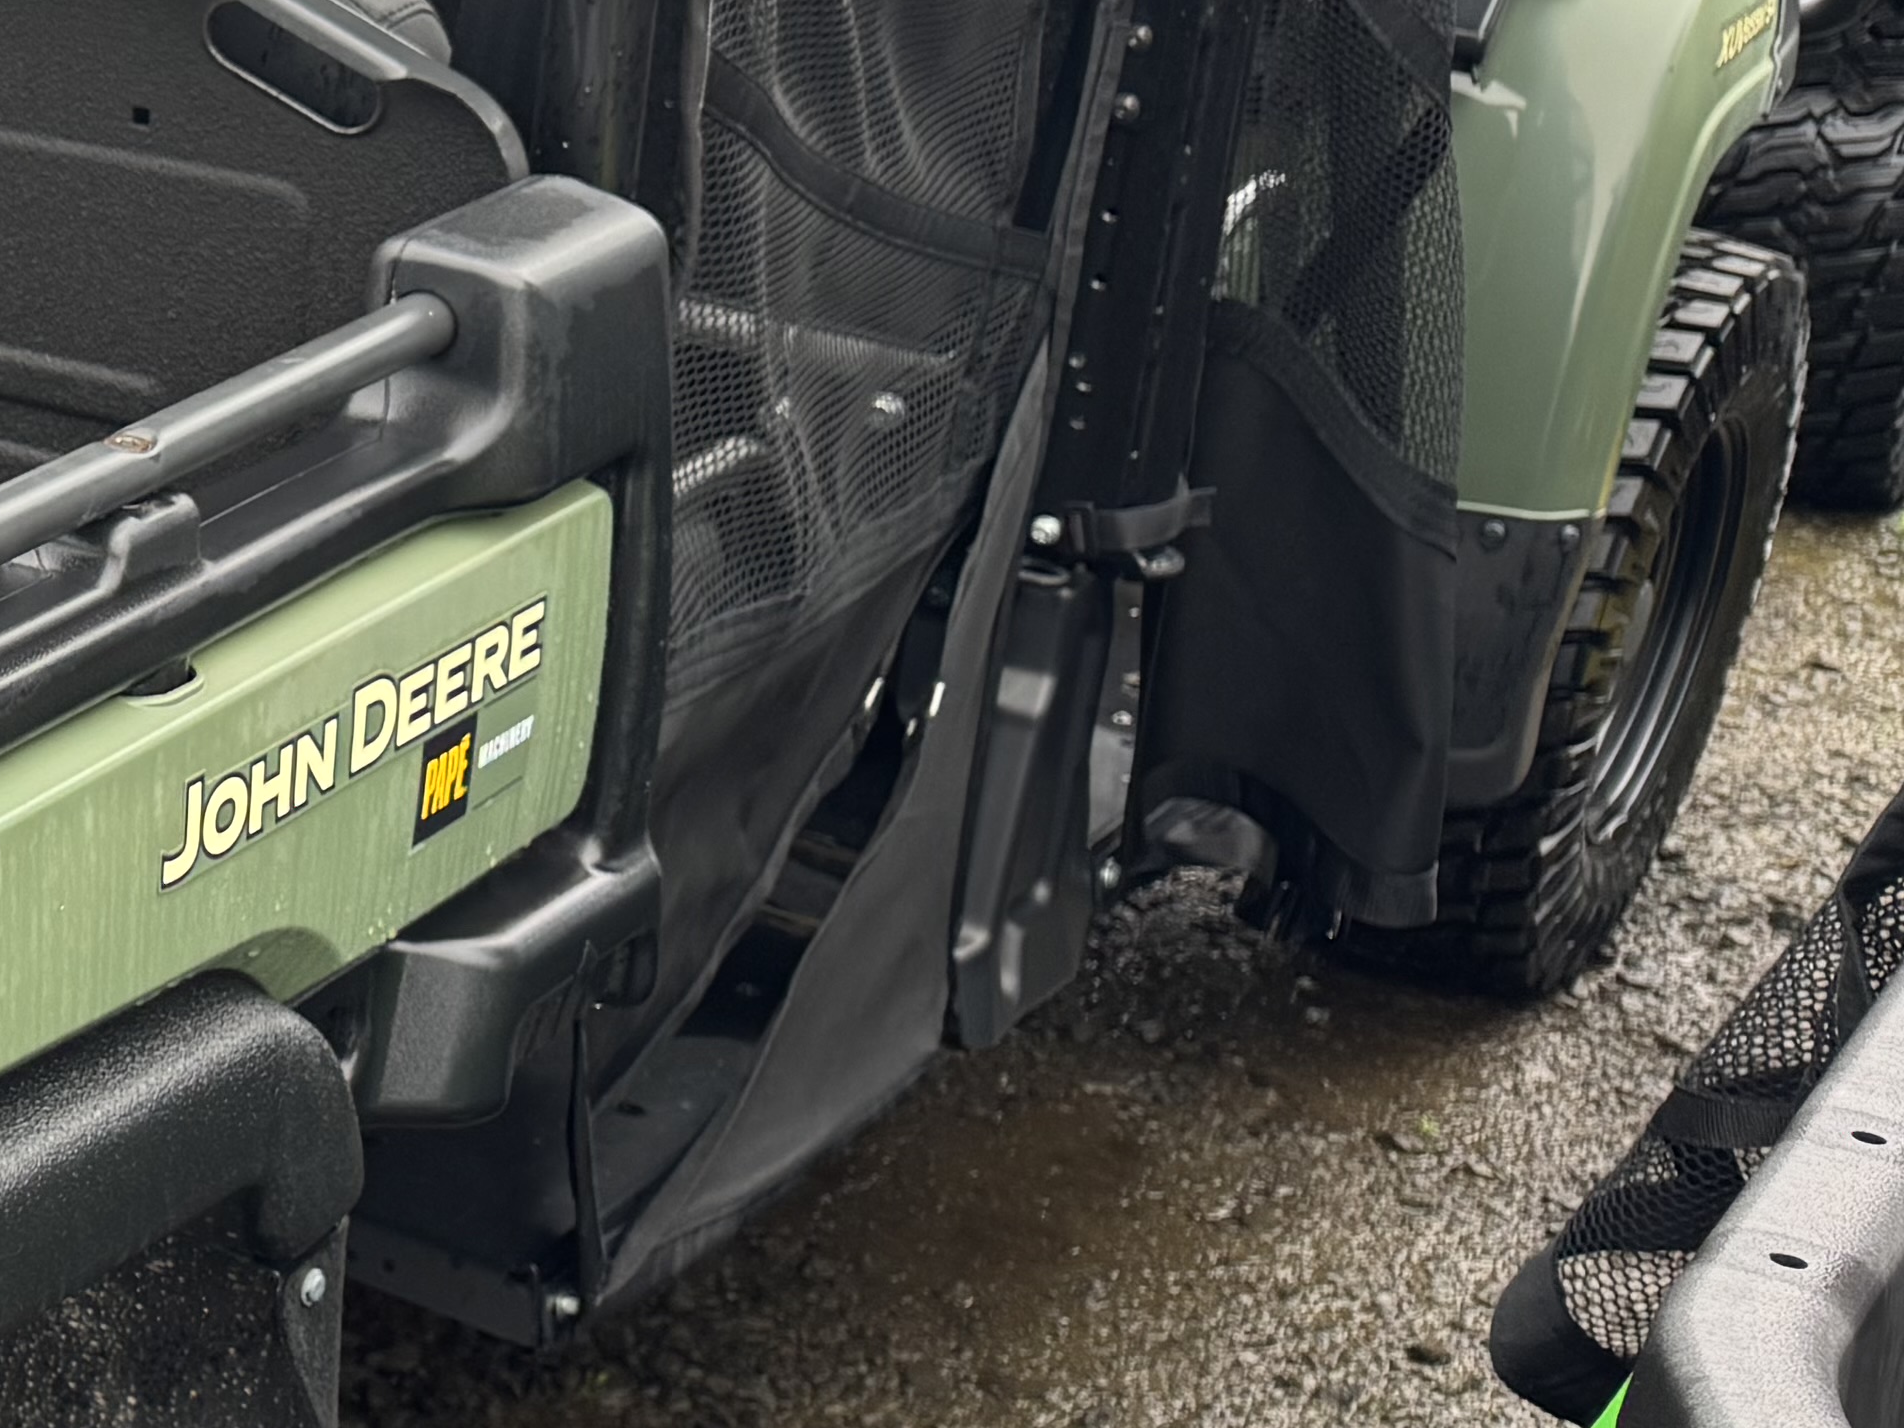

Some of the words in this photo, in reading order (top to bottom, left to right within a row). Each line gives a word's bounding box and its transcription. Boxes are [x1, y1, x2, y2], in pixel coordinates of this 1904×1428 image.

[160, 715, 341, 890] JOHN
[349, 596, 547, 779] DEERE
[478, 714, 536, 769] MACHINERY
